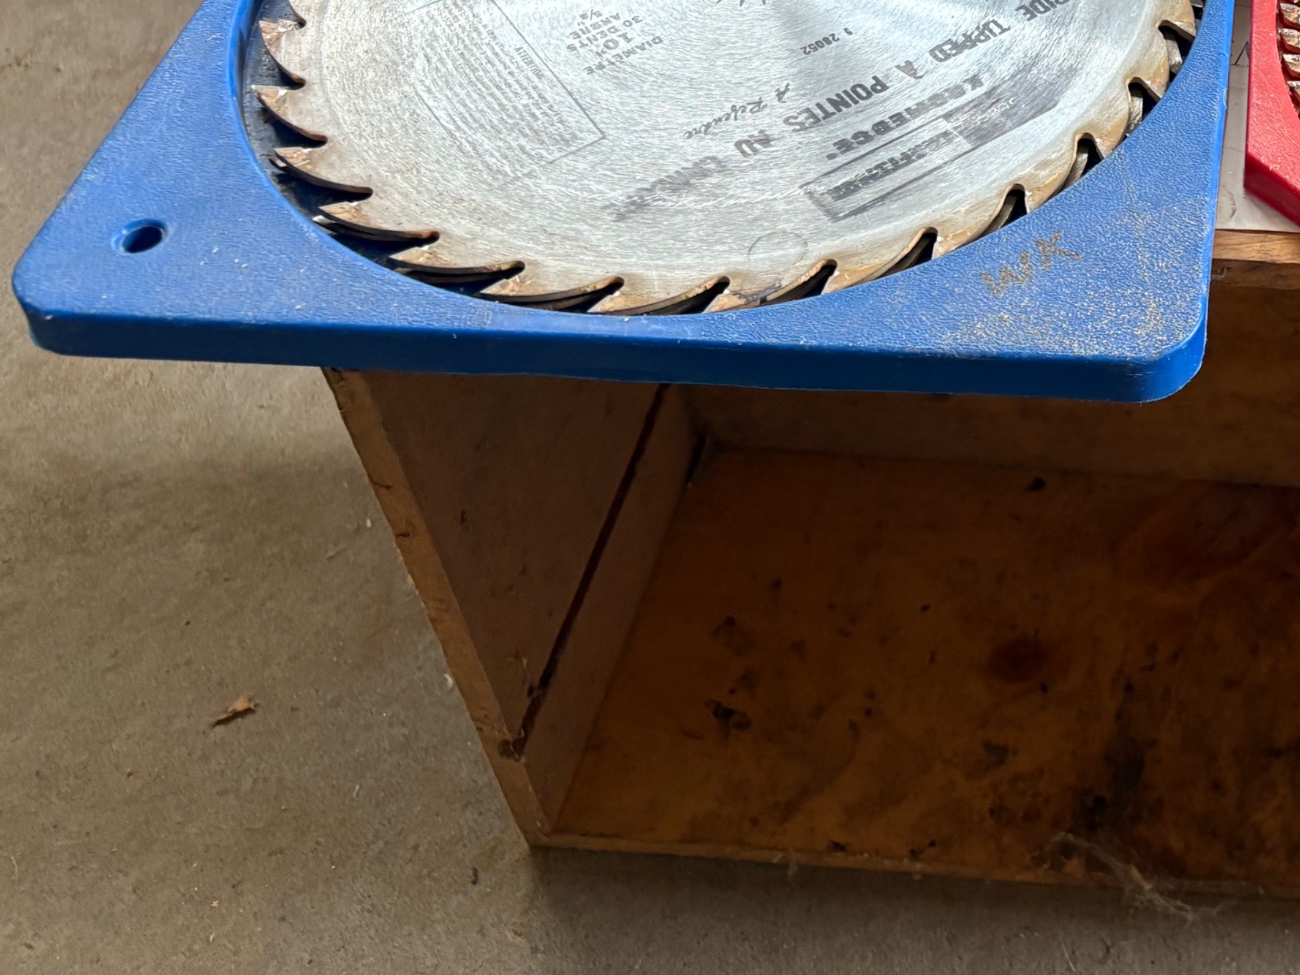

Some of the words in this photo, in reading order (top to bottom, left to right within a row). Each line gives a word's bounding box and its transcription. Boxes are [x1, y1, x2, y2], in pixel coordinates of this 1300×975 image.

[567, 12, 624, 40] ARBRE
[620, 14, 644, 28] 30
[564, 24, 620, 53] DENTS
[797, 32, 840, 57] 28052
[924, 14, 1011, 65] TIPPED
[779, 73, 888, 135] POINTES
[678, 95, 769, 144] Refendre
